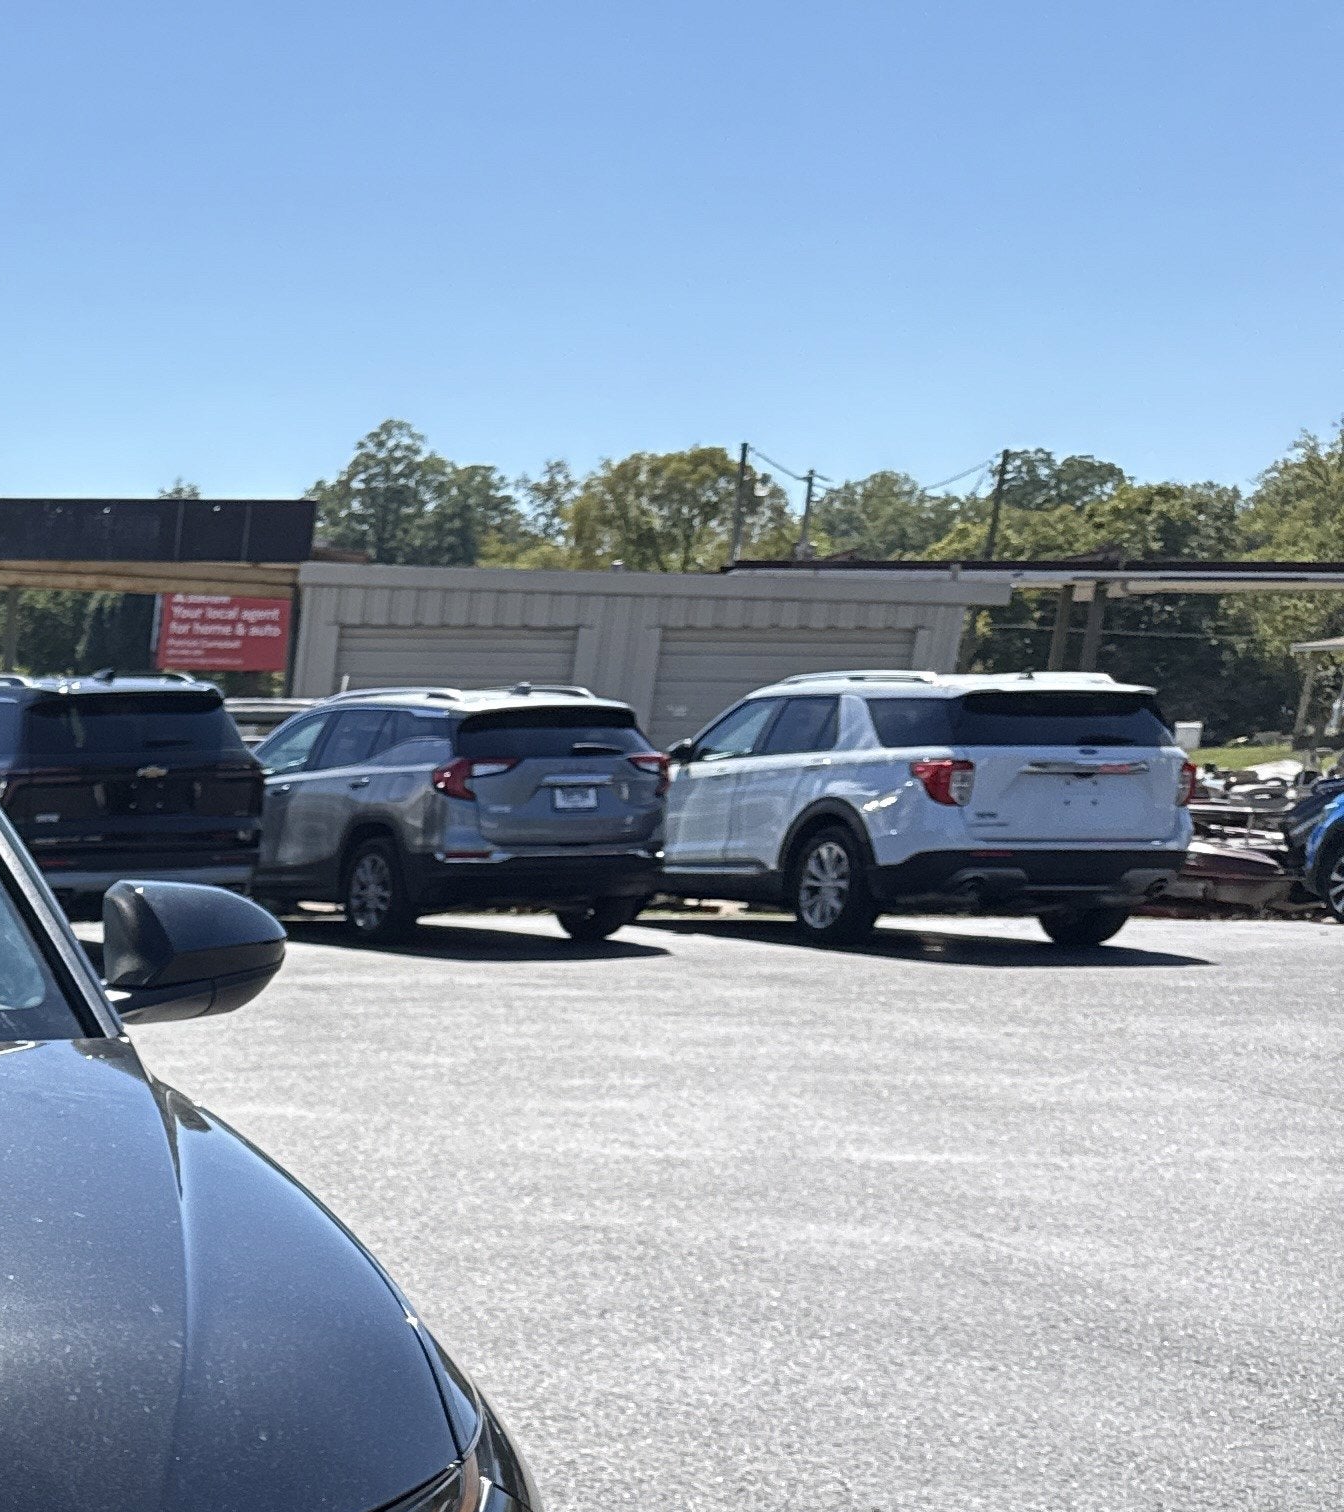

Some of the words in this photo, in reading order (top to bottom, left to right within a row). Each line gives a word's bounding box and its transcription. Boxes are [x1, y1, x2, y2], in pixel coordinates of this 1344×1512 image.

[172, 605, 203, 619] Your
[205, 606, 239, 619] local
[241, 608, 280, 622] agent
[169, 621, 191, 634] for
[192, 622, 232, 635] home
[235, 622, 246, 636] &
[248, 624, 281, 637] auto
